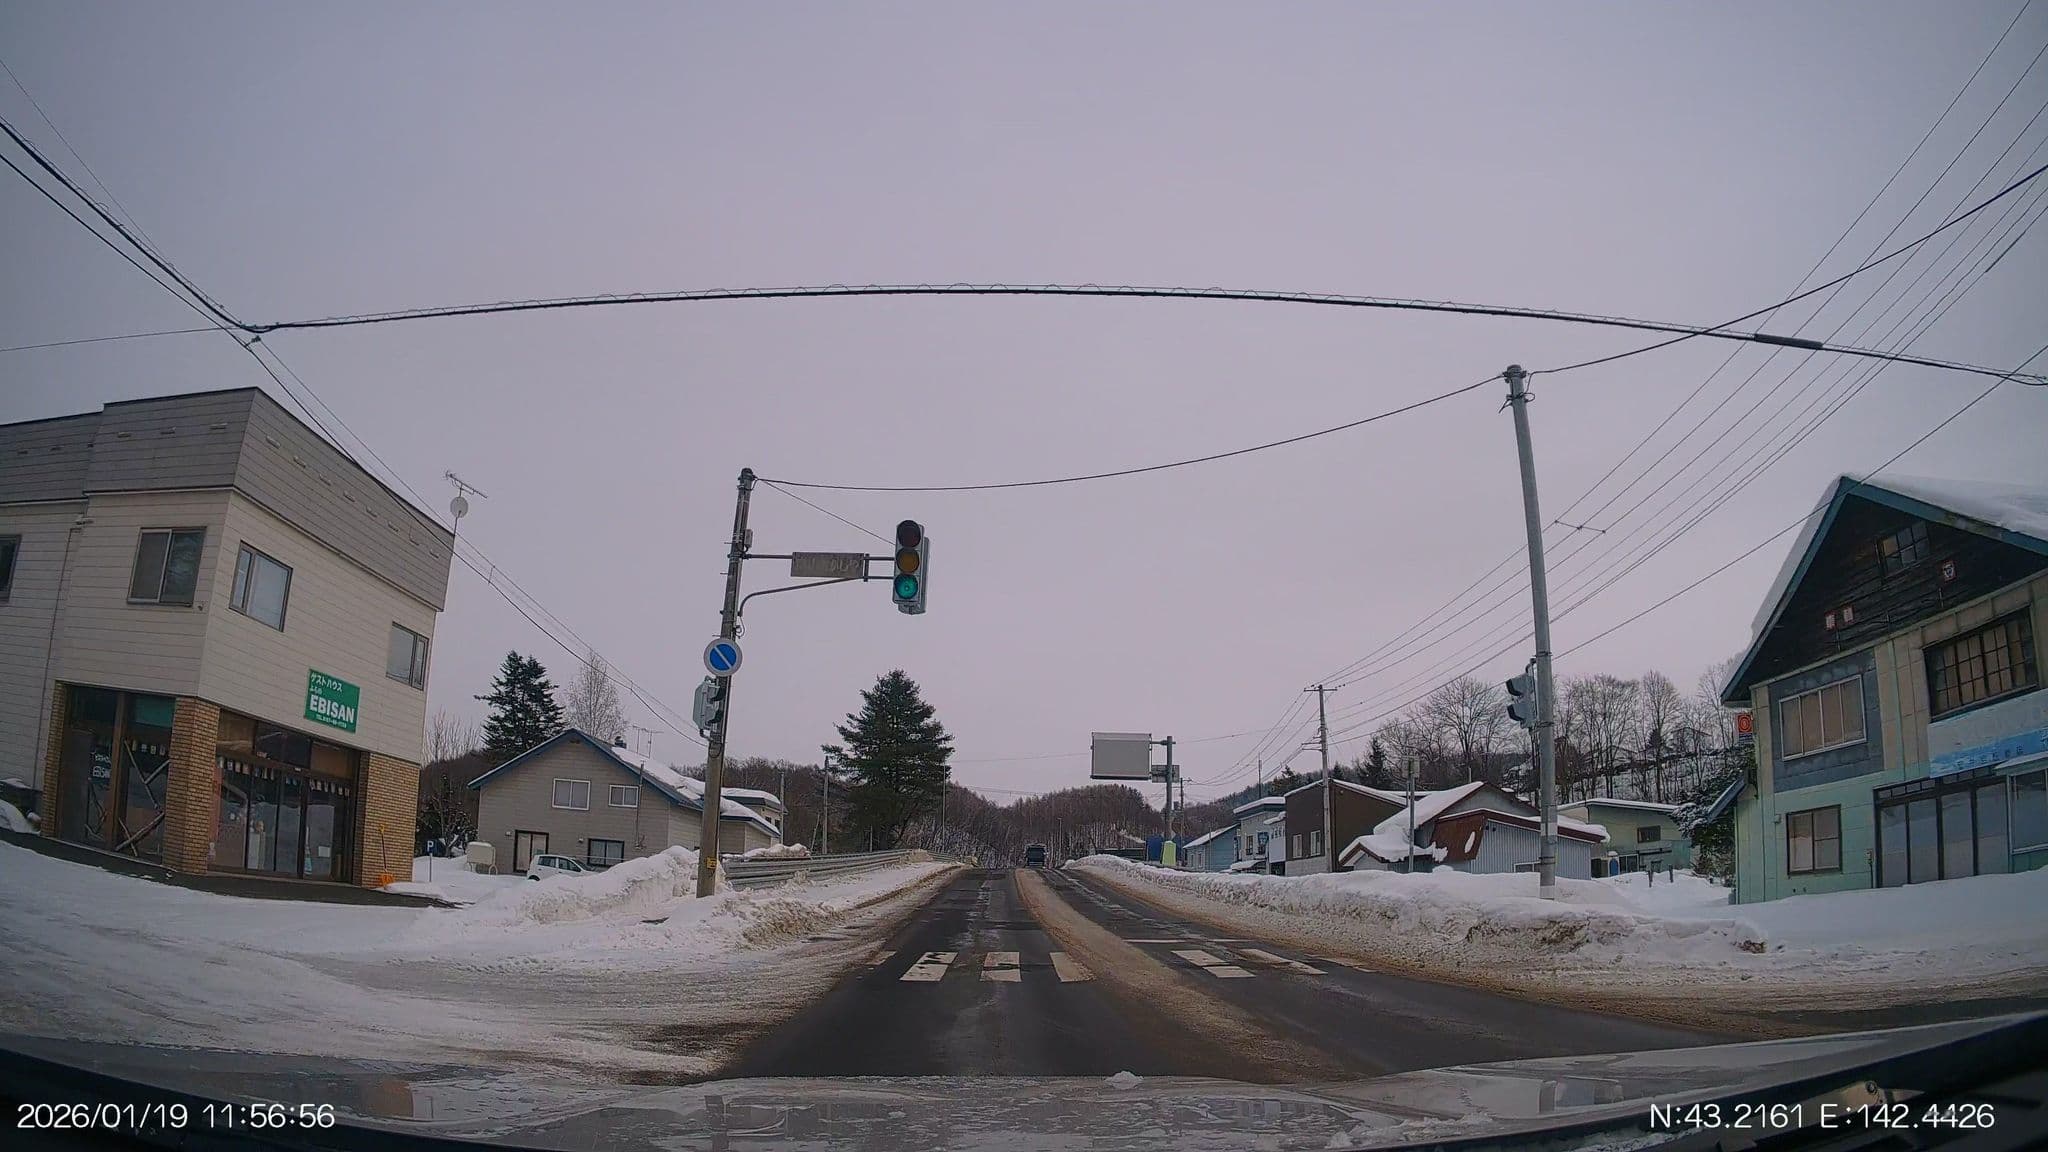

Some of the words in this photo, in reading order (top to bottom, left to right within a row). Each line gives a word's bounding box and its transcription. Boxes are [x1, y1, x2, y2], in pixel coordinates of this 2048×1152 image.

[311, 672, 342, 692] ゲストハウス
[310, 694, 355, 723] EBISAN
[427, 840, 434, 852] P
